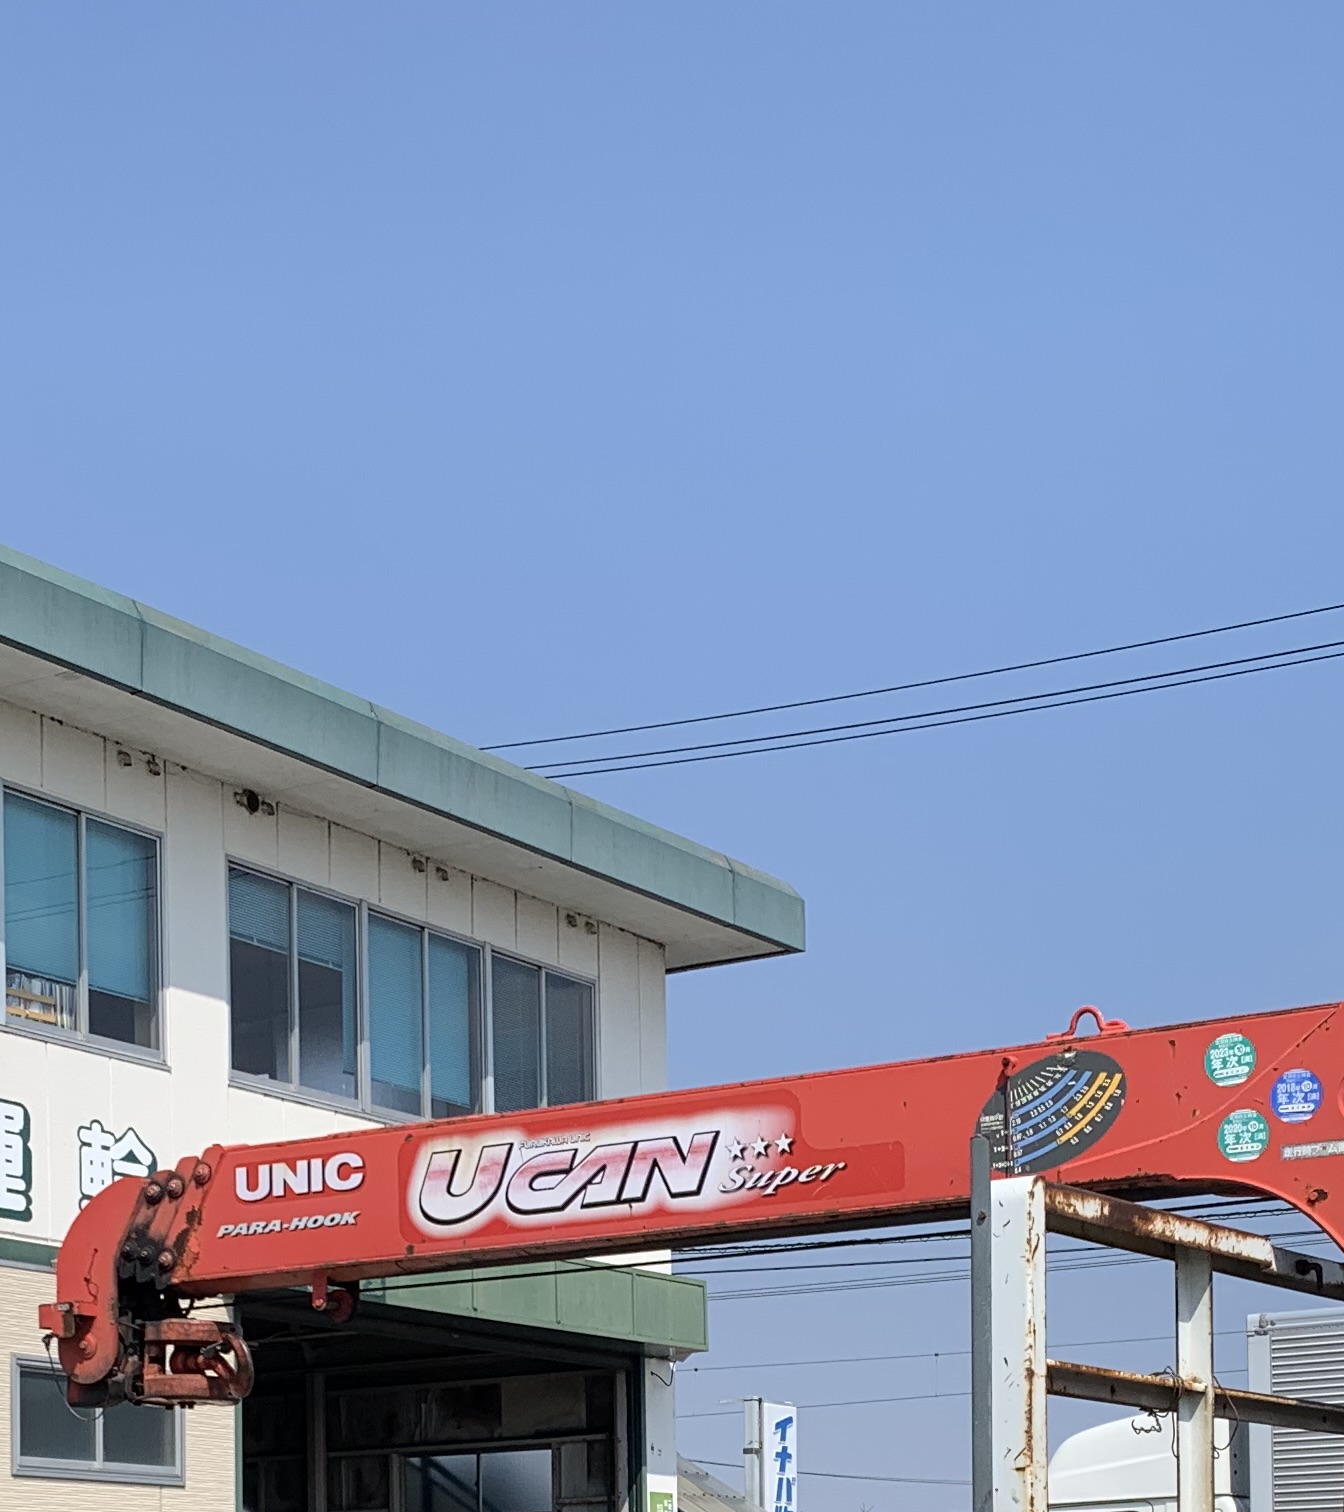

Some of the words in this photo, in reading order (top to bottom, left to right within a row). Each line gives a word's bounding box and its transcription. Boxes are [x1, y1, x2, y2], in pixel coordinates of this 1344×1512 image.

[235, 1152, 365, 1202] UNIC
[718, 1159, 847, 1197] Super
[216, 1210, 361, 1239] PARA-HOOK
